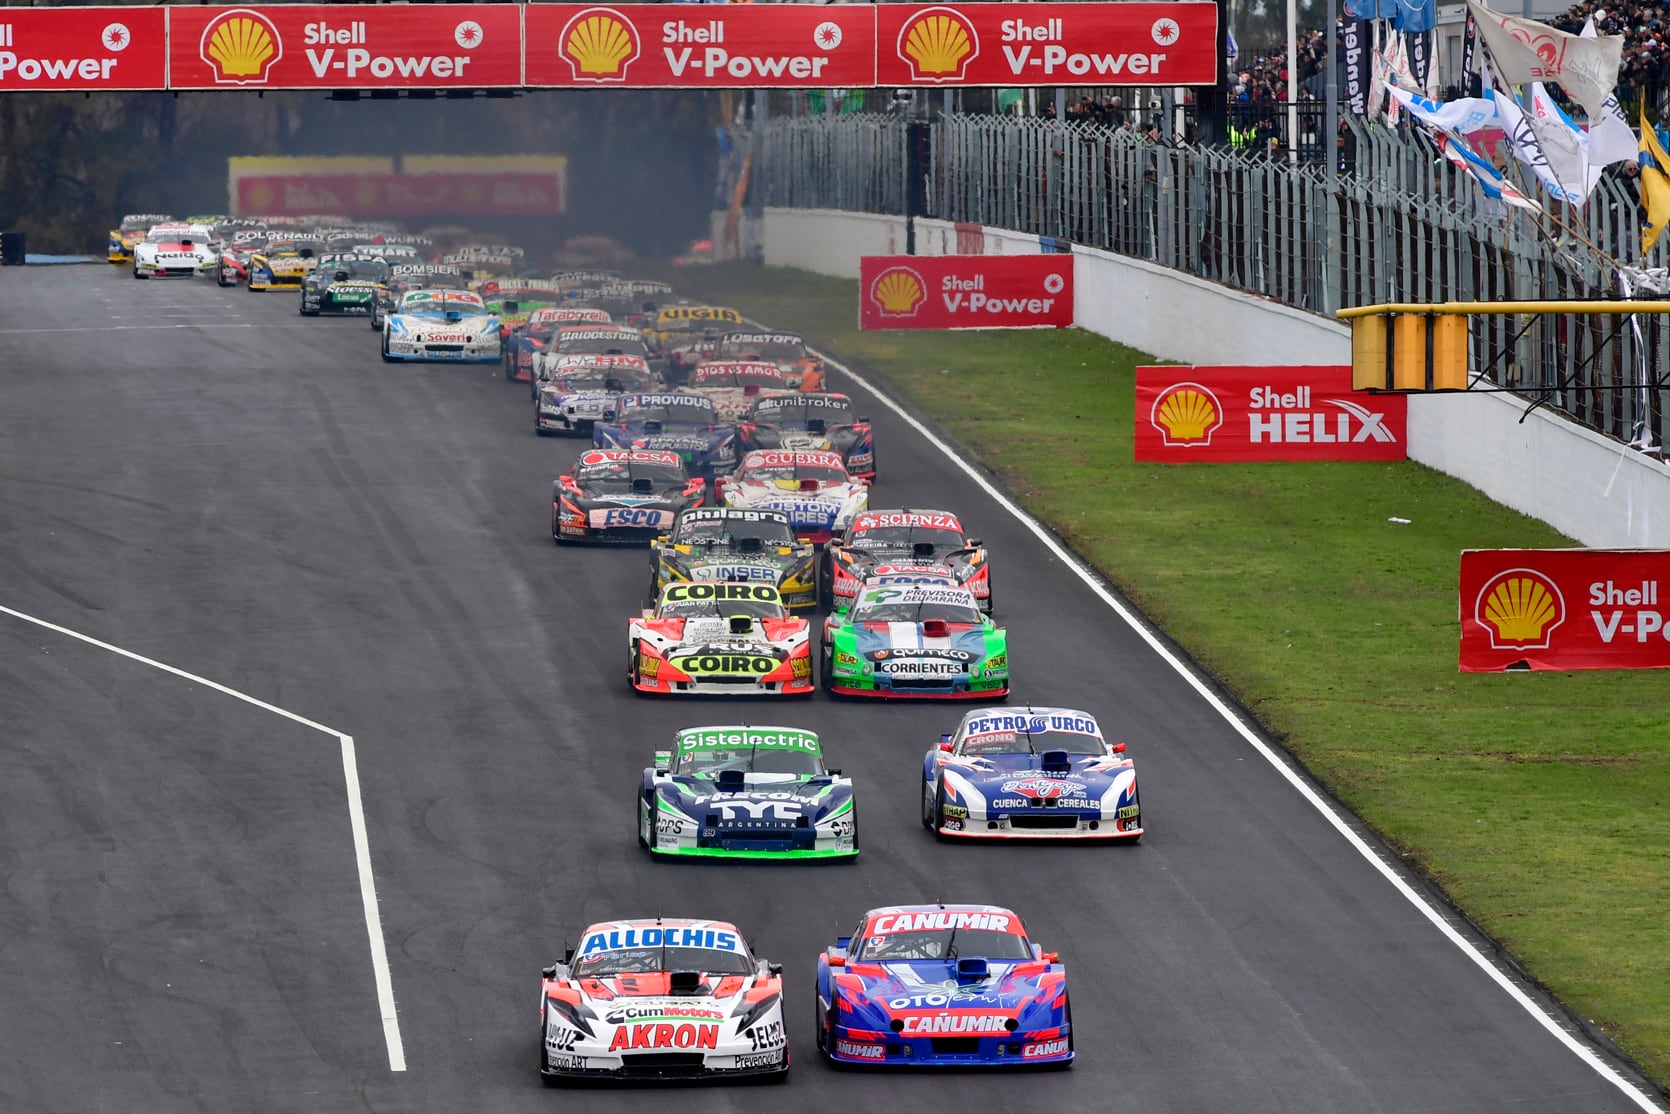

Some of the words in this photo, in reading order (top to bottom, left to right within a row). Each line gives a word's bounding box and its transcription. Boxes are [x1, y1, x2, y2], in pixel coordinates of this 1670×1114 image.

[304, 21, 365, 45] Shell
[663, 21, 724, 43] Shell
[1001, 19, 1062, 41] Shell
[305, 50, 470, 78] V-Power
[664, 48, 828, 77] V-Power
[1002, 45, 1166, 75] V-Power
[942, 274, 983, 290] Shell
[943, 293, 1054, 313] V-Power
[745, 366, 782, 378] AMOR
[641, 395, 711, 409] PROVIDUS
[774, 397, 848, 410] unibroker
[1250, 386, 1310, 409] Shell
[1248, 412, 1397, 442] HELIX
[609, 453, 674, 464] TACSA
[765, 454, 842, 465] GUERRA
[604, 508, 662, 526] ESCO
[880, 515, 957, 529] SCIENZA
[716, 567, 775, 579] INSER
[667, 584, 777, 600] COIRO
[906, 589, 971, 601] PREVISORA
[1589, 580, 1657, 605] Shell
[682, 657, 773, 672] COIRO
[881, 663, 962, 674] CORRIENTES
[683, 732, 817, 751] Sistelectric
[968, 734, 1014, 746] CRONO
[710, 801, 802, 819] TYC
[993, 799, 1027, 809] CUENCA
[1058, 799, 1101, 810] CEREALES
[718, 821, 796, 829] ARGENTINA
[583, 928, 736, 954] ALLOCHIS
[625, 1007, 724, 1020] CumMotors
[608, 1024, 719, 1052] AKRON
